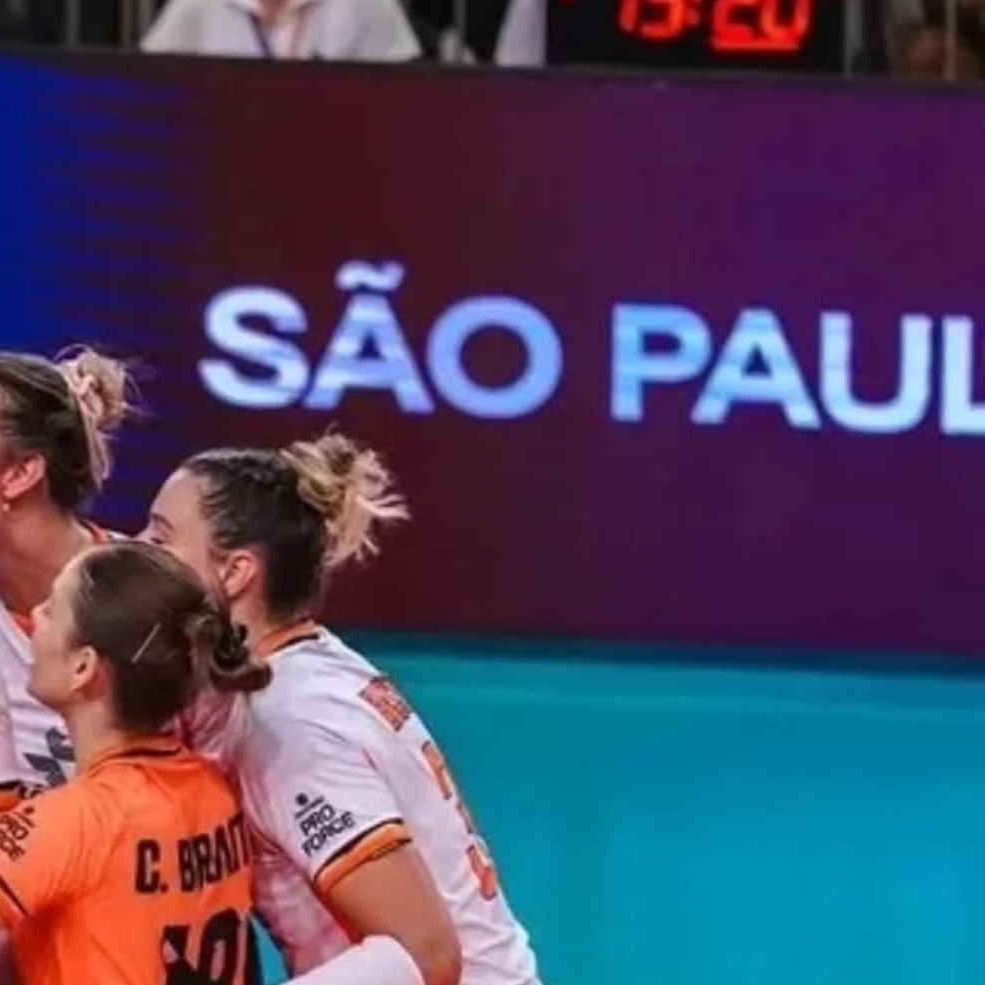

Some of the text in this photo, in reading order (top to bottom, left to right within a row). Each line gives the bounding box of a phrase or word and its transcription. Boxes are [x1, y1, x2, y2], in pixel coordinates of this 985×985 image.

[198, 260, 985, 435] SÃO PAUL
[300, 803, 336, 836] PRO
[301, 811, 356, 859] FORCE
[135, 838, 169, 894] C.
